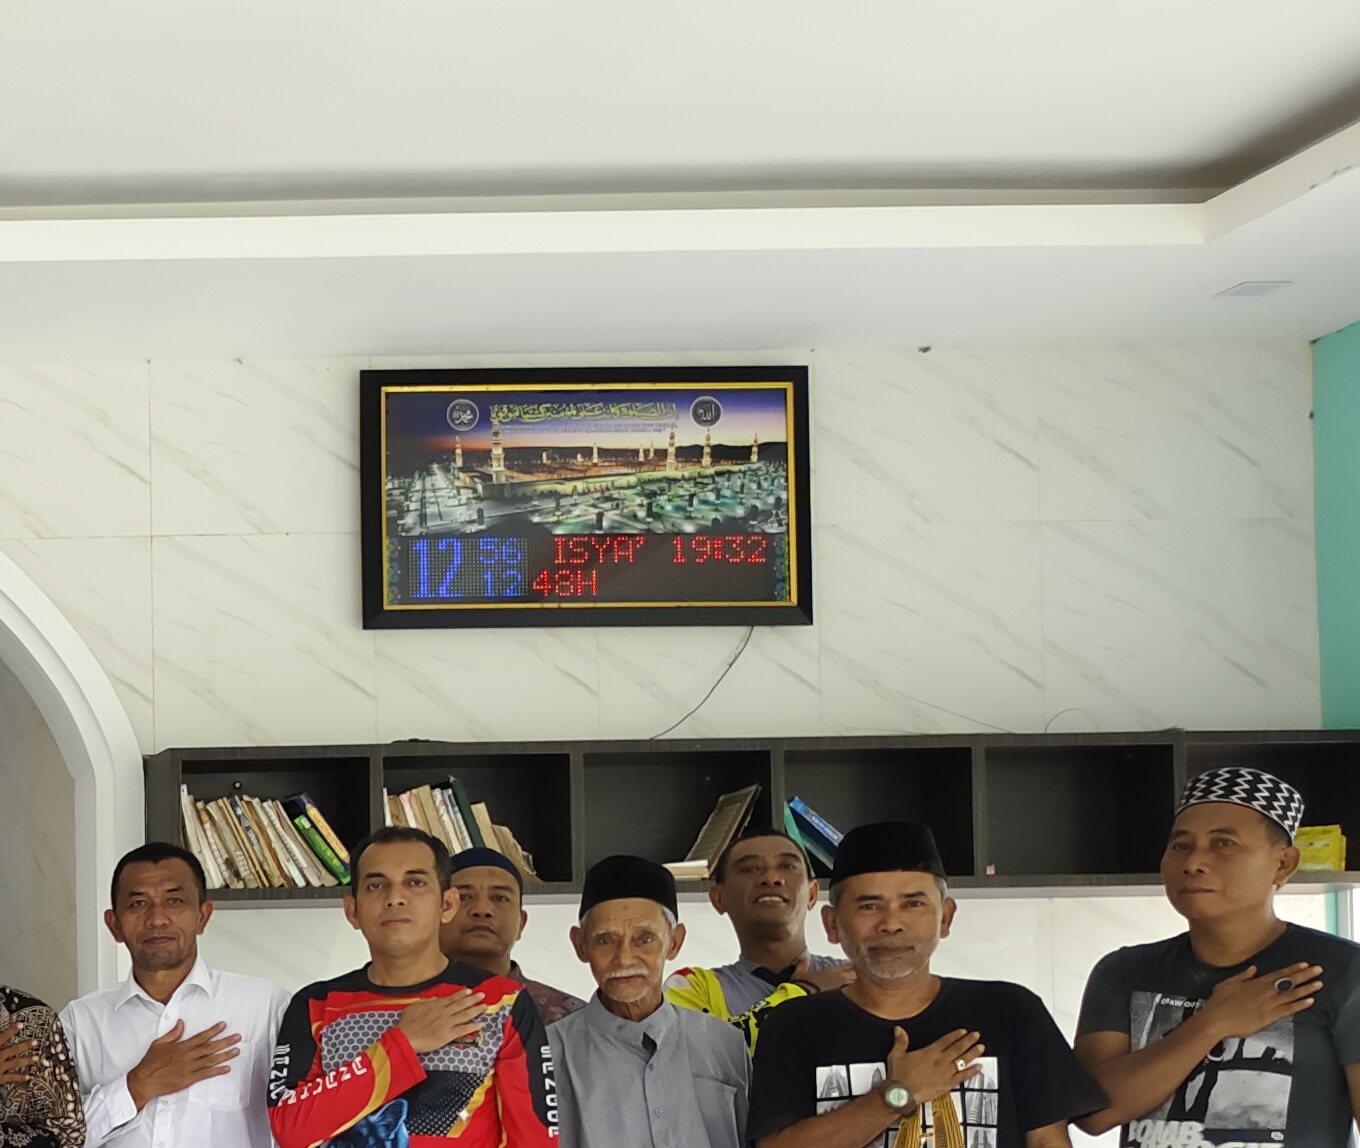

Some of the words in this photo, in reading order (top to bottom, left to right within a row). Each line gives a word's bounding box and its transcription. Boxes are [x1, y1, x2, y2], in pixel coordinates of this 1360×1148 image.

[672, 535, 768, 563] 19:32
[412, 537, 463, 598] 12
[482, 569, 523, 598] 12
